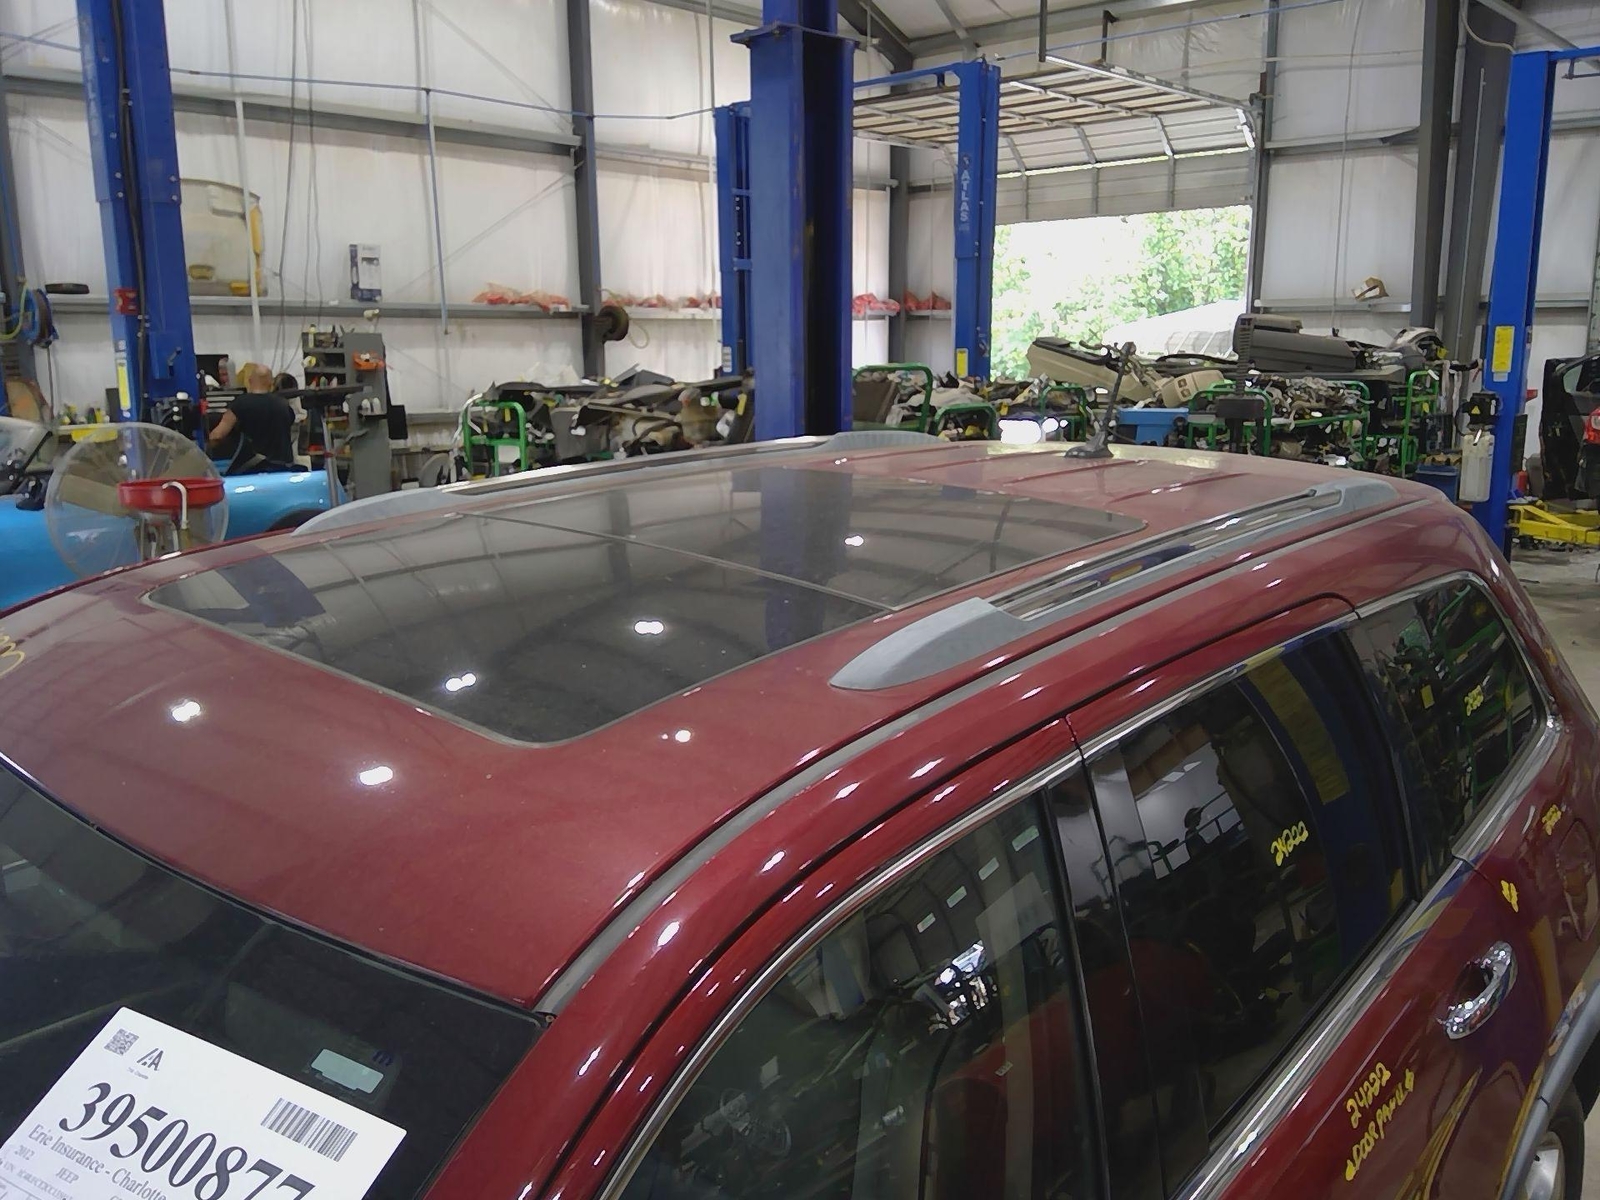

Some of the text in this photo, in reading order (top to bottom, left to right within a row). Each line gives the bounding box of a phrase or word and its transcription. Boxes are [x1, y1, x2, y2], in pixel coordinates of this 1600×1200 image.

[960, 169, 971, 222] ATLAS
[50, 1136, 105, 1174] Insurance
[59, 1082, 316, 1200] 39500877
[55, 1167, 80, 1184] JEEP
